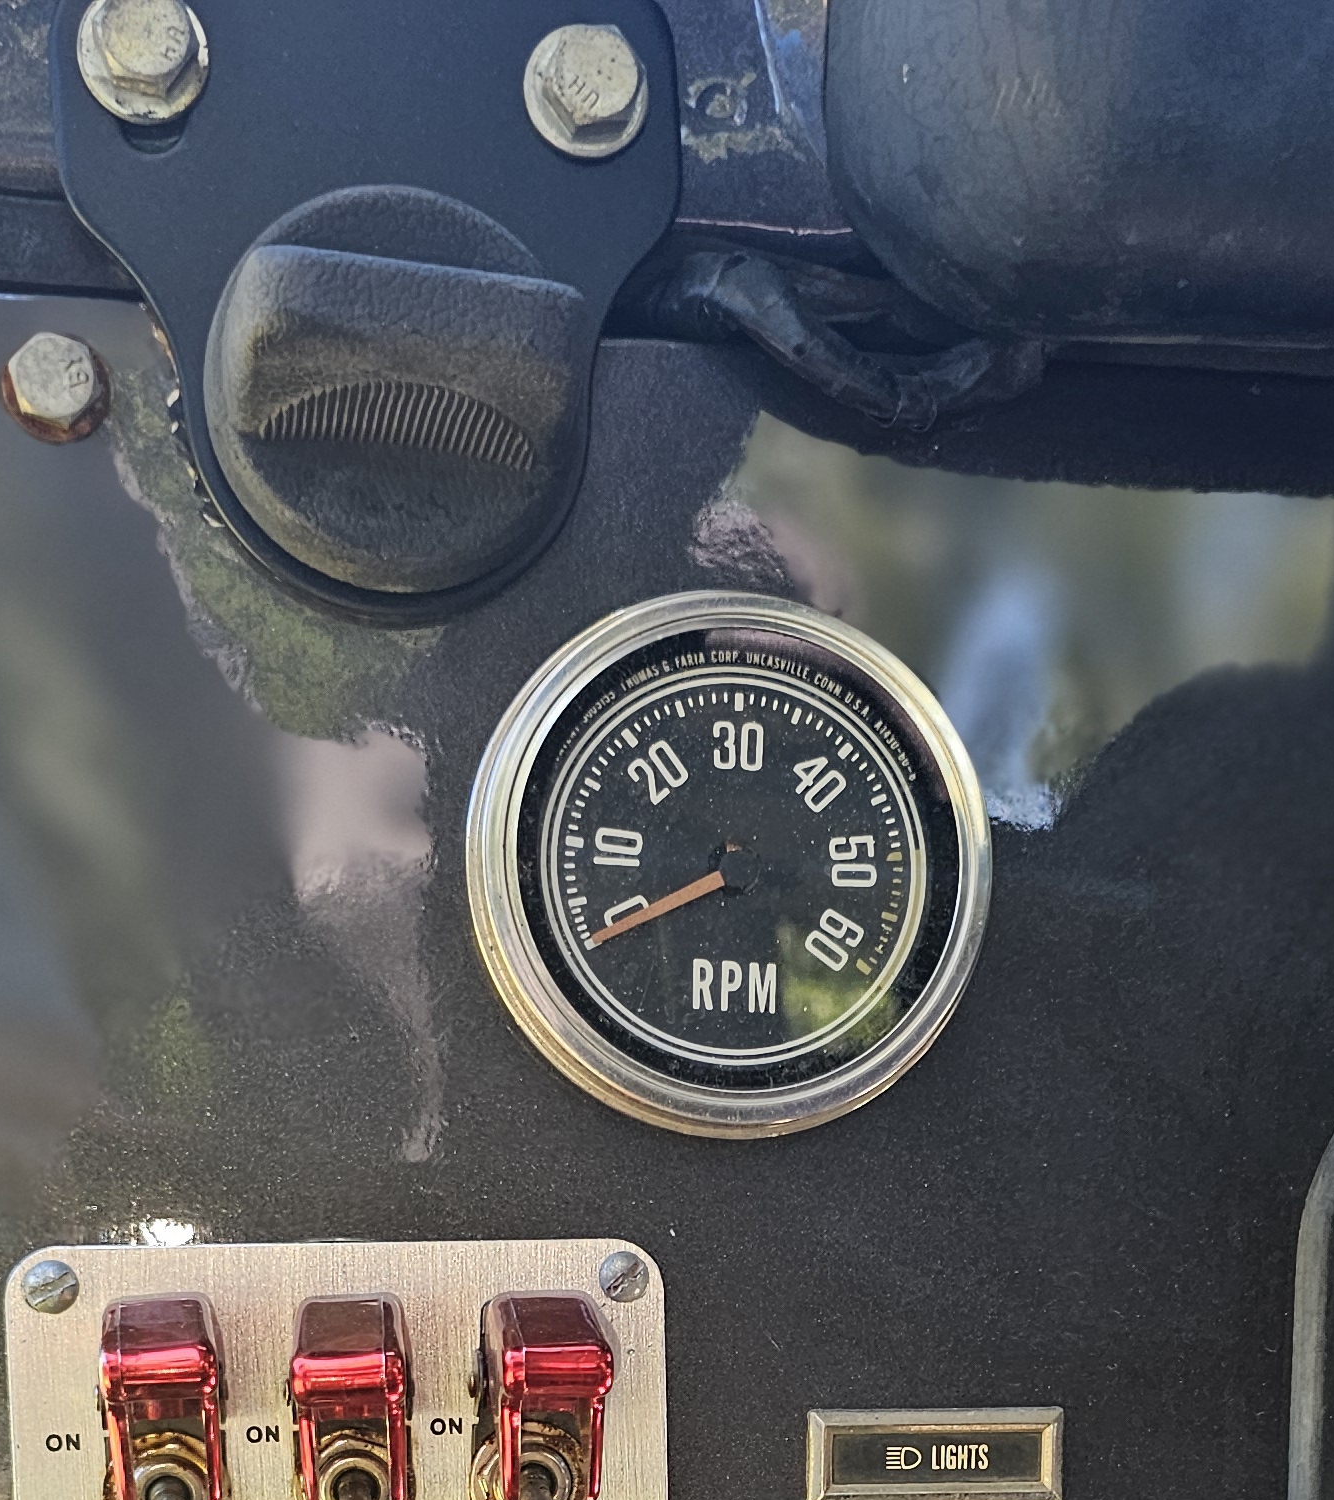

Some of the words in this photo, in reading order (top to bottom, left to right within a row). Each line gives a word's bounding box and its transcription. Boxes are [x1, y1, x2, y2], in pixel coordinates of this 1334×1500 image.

[675, 652, 706, 669] FARIA
[711, 650, 741, 664] CORP.
[814, 673, 842, 699] CONN.
[713, 721, 764, 771] 30
[627, 740, 689, 805] 20
[793, 756, 847, 813] 40
[593, 827, 644, 867] 10
[829, 834, 878, 888] 50
[804, 908, 865, 972] 60
[692, 957, 777, 1015] RPM
[46, 1433, 81, 1452] ON
[246, 1425, 280, 1444] ON
[430, 1418, 463, 1436] ON
[931, 1443, 989, 1470] LIGHTS
